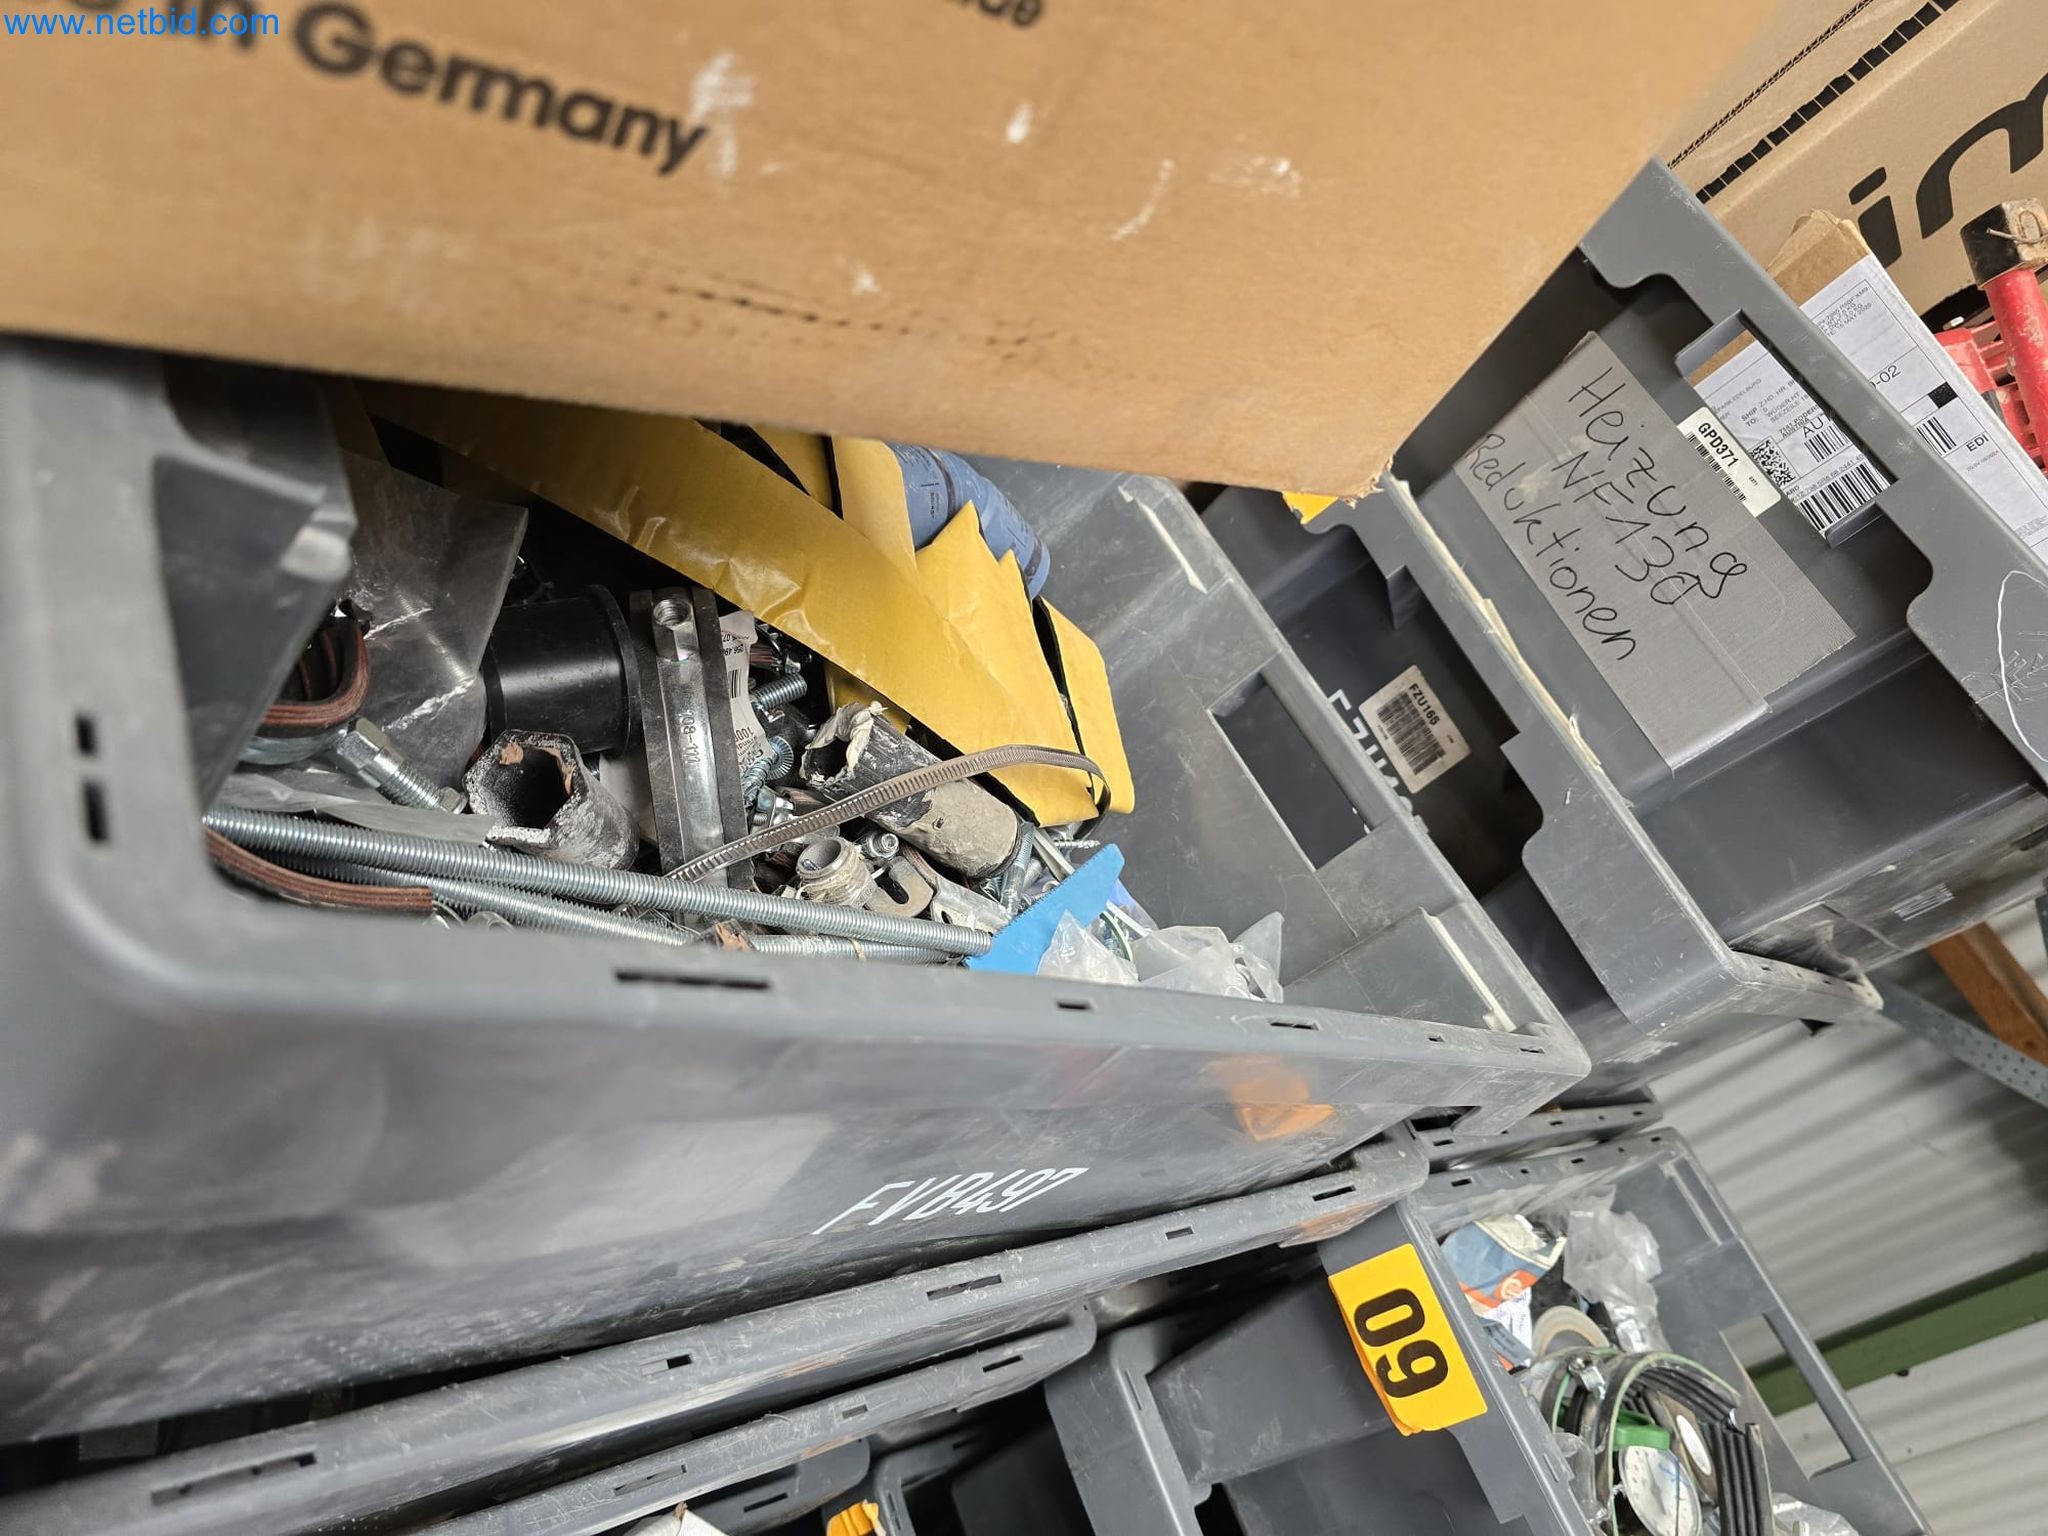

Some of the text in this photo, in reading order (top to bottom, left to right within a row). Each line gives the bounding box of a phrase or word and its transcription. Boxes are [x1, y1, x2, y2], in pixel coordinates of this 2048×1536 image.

[293, 0, 709, 176] Germany
[1739, 406, 1759, 422] SHIP
[1745, 415, 1759, 427] TO:
[1780, 416, 1809, 438] AUSTRIA
[1698, 421, 1739, 468] GPD371
[1966, 434, 1989, 452] EDI
[1568, 366, 1747, 599] Heizung
[1468, 434, 1636, 661] Reduktionen
[1409, 683, 1440, 726] FZU165
[679, 709, 701, 764] 108-111
[811, 1167, 1089, 1236] FVB497
